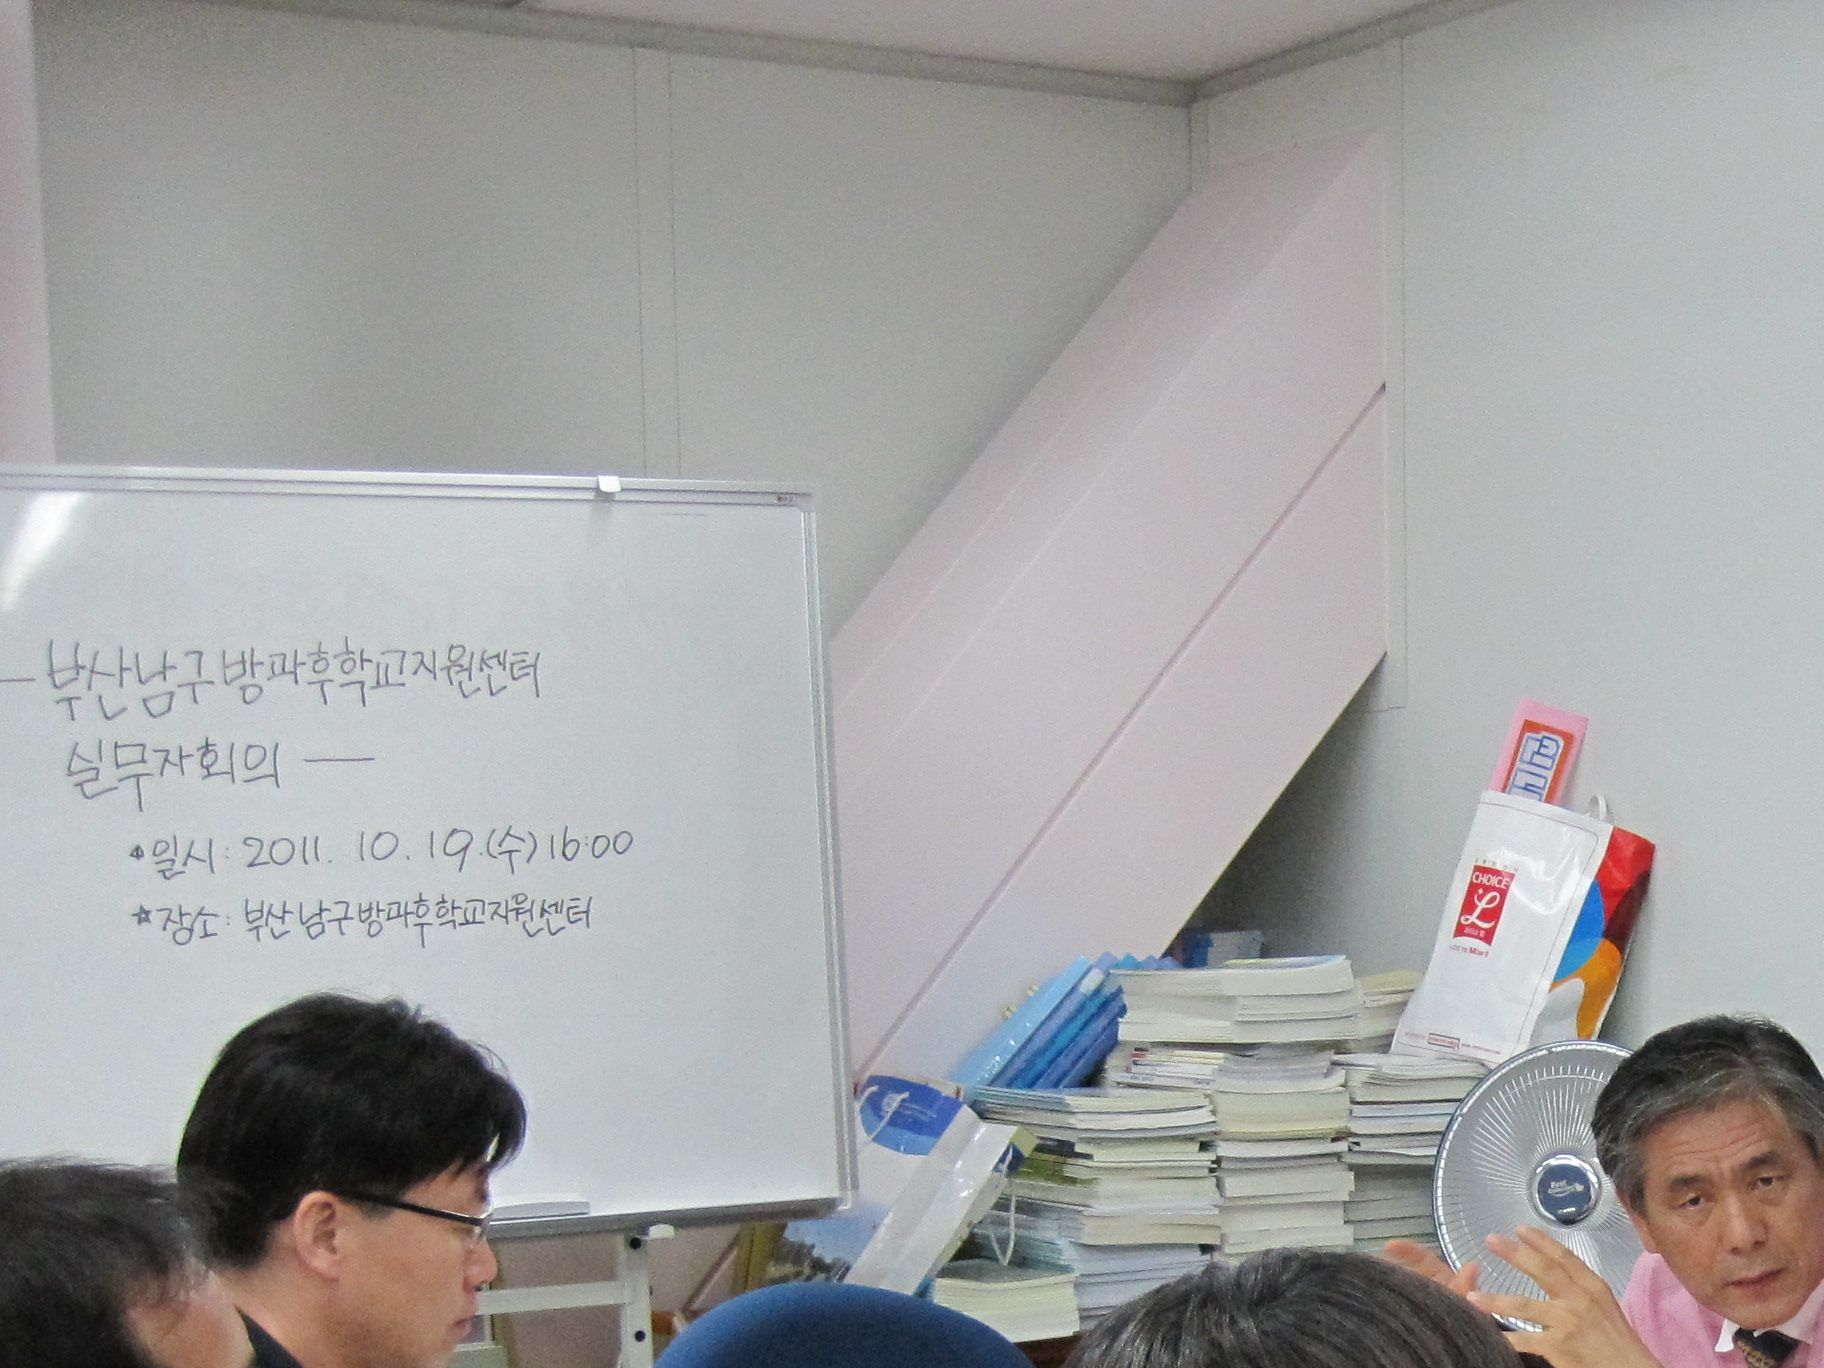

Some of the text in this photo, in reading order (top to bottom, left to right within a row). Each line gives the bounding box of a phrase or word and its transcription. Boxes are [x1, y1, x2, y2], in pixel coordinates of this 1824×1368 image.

[64, 736, 282, 813] 실무자회의
[151, 834, 232, 881] 일시:
[1471, 871, 1510, 890] CHOICE
[155, 903, 232, 947] 장소:
